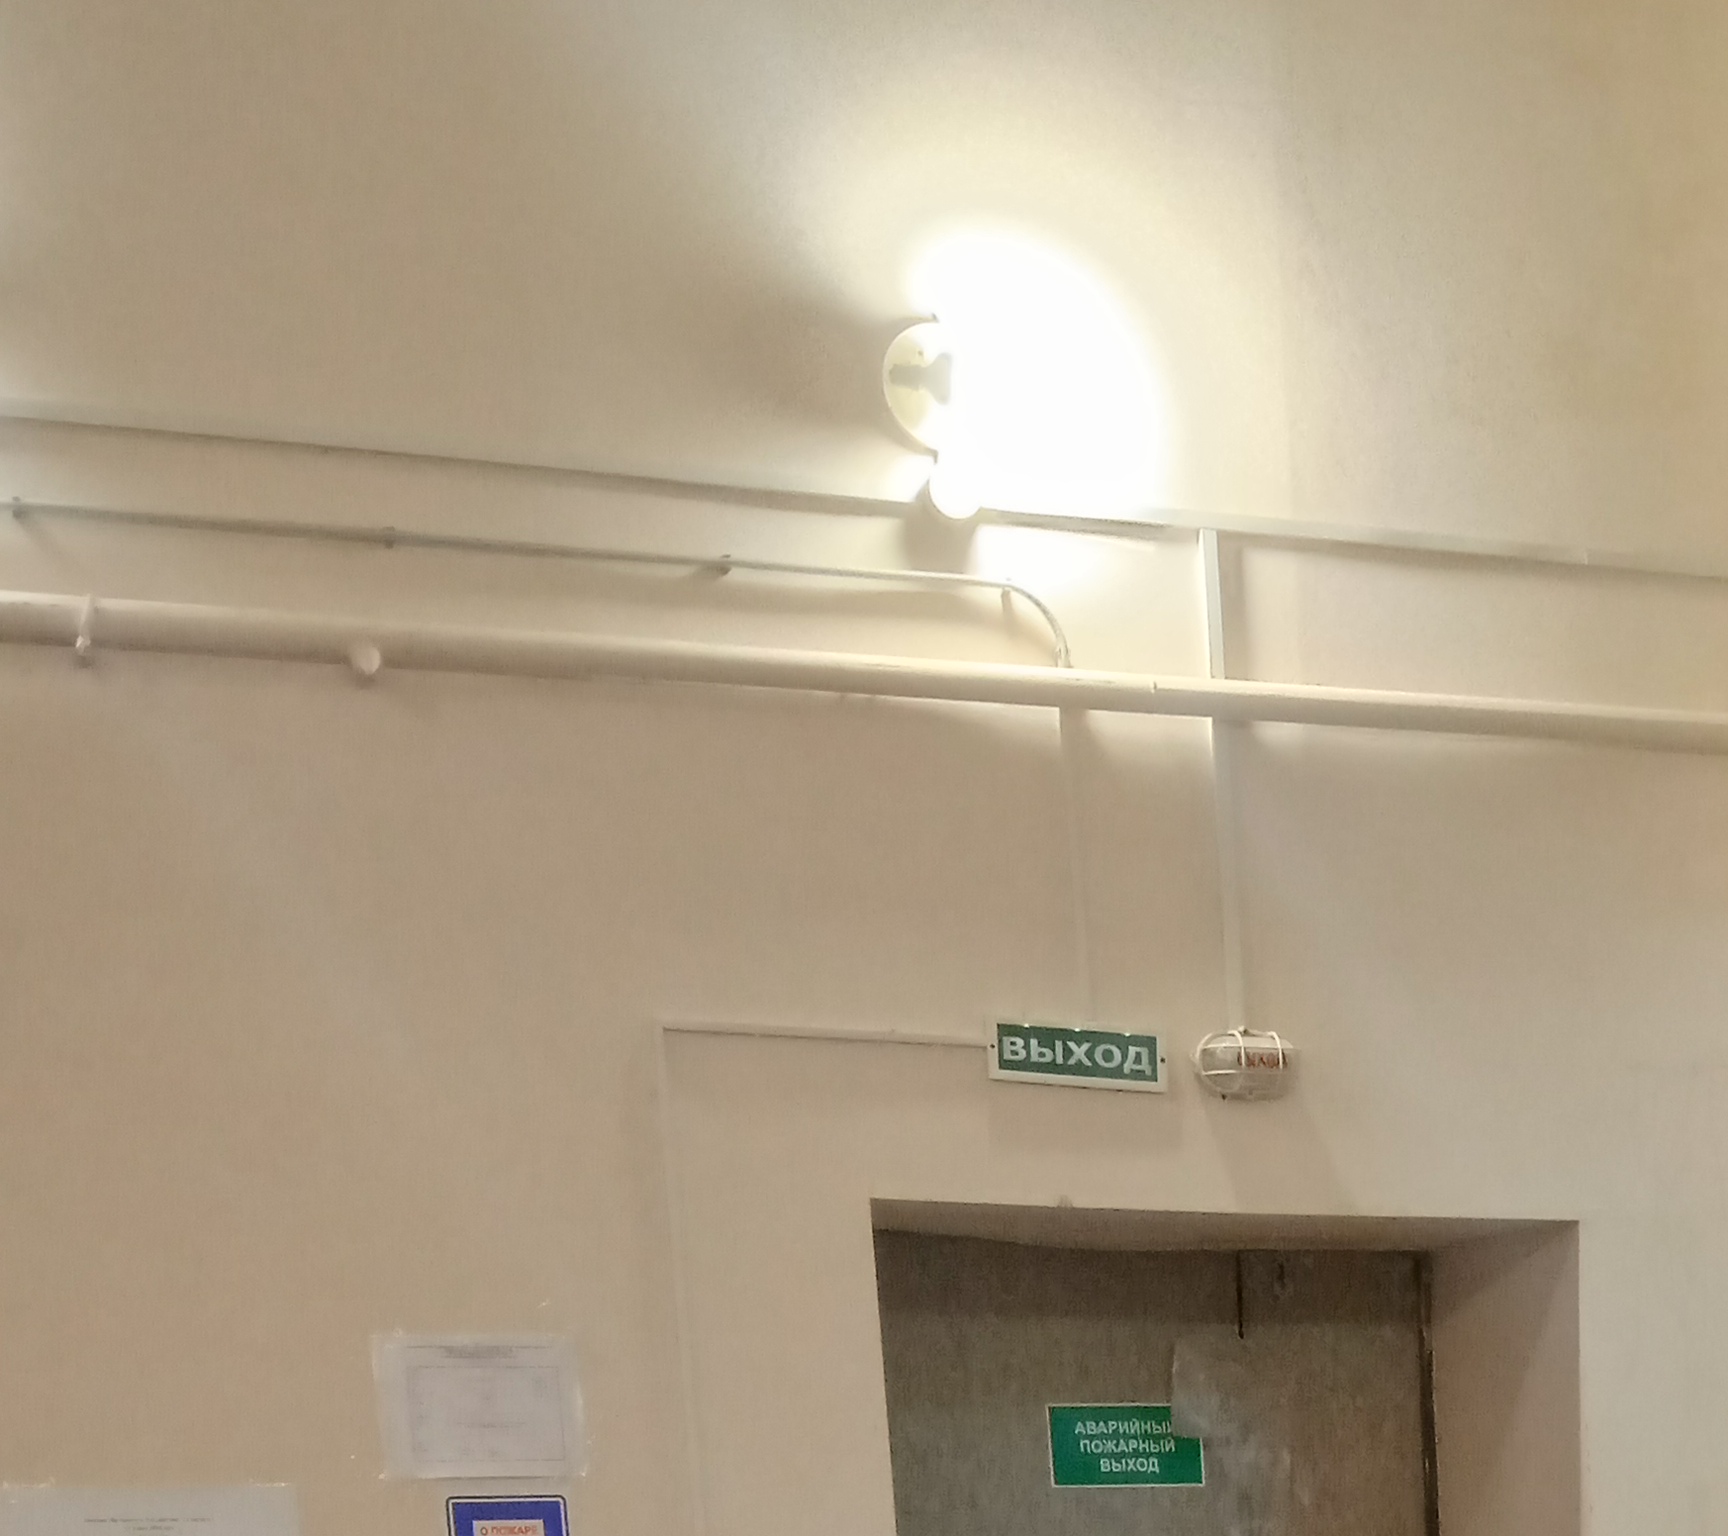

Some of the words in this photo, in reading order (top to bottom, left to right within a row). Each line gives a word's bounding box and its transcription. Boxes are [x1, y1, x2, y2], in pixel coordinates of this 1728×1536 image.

[1002, 1036, 1152, 1076] ВЫХОД
[1080, 1438, 1176, 1454] ПОЖАРНЫЙ
[1100, 1458, 1159, 1474] ВЫХОД
